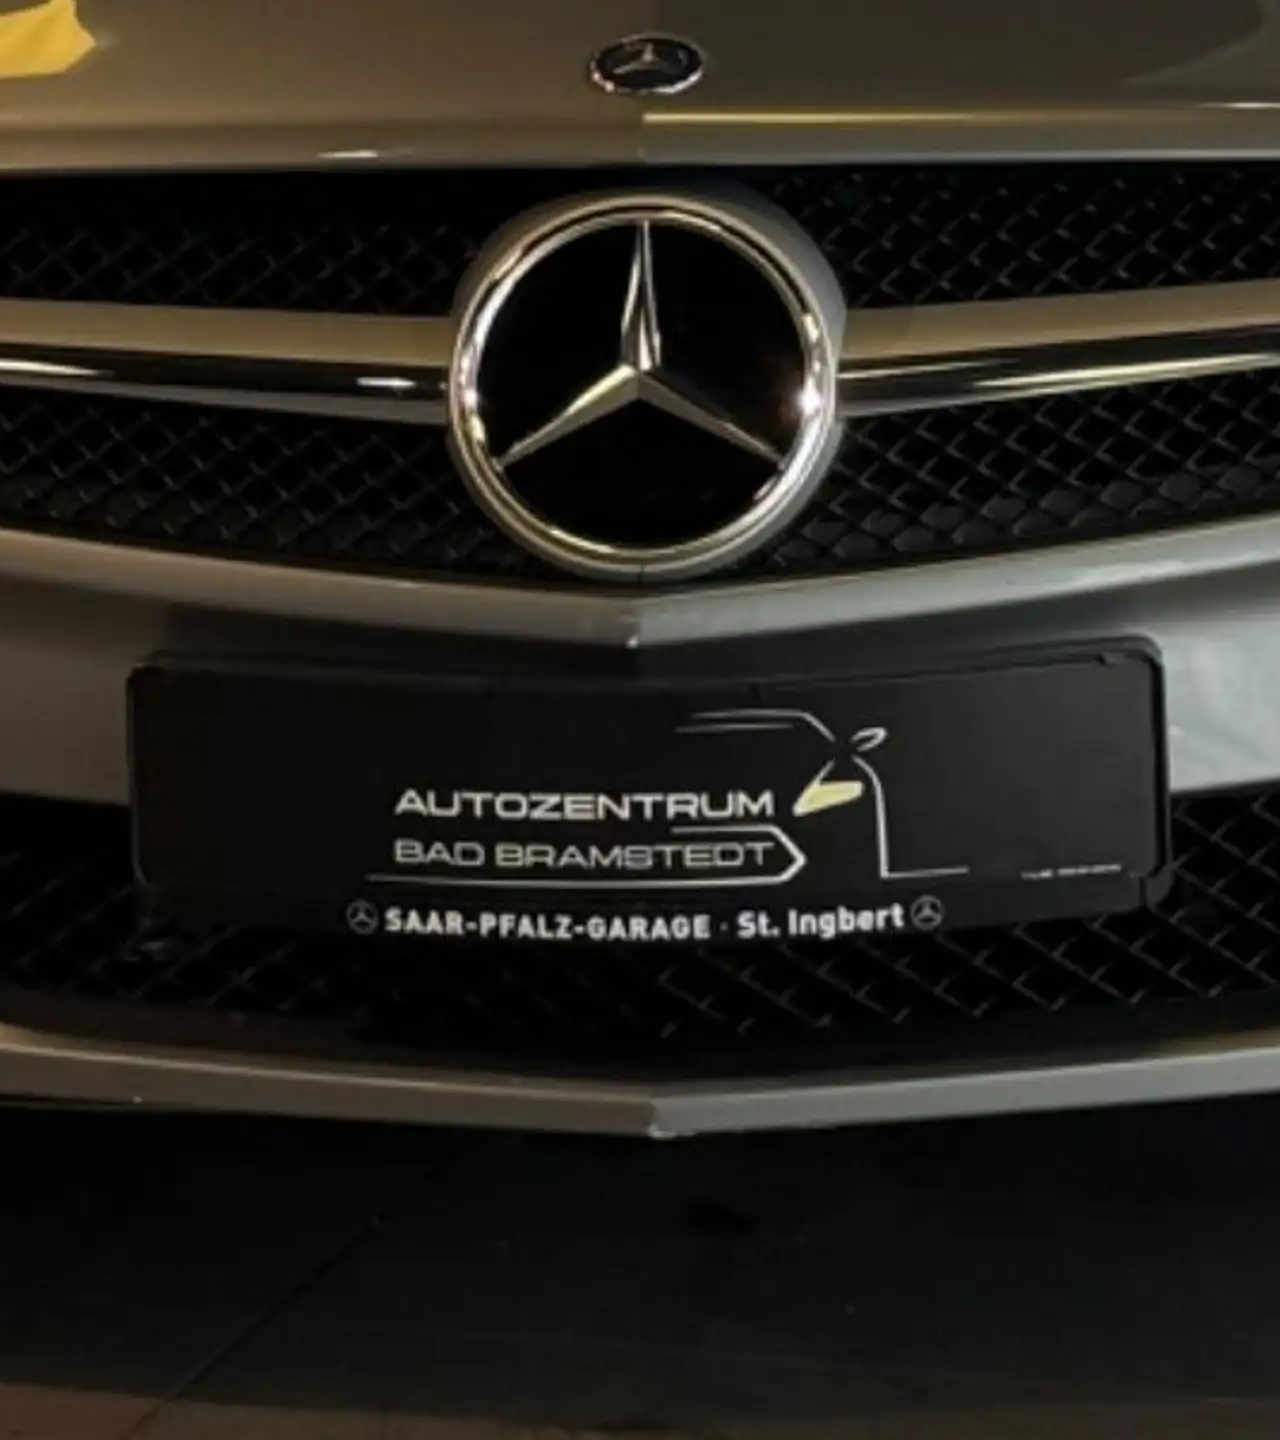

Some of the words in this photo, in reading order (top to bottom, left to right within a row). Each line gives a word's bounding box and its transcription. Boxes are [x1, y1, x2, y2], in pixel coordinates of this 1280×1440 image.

[394, 788, 776, 821] AUTOZENTRUM
[393, 838, 487, 867] BAD
[493, 841, 776, 870] BRAMSTEDT
[384, 906, 712, 941] SAAR-PFALZ-GARAGE
[736, 909, 781, 939] St.
[787, 901, 906, 940] Ingbert
